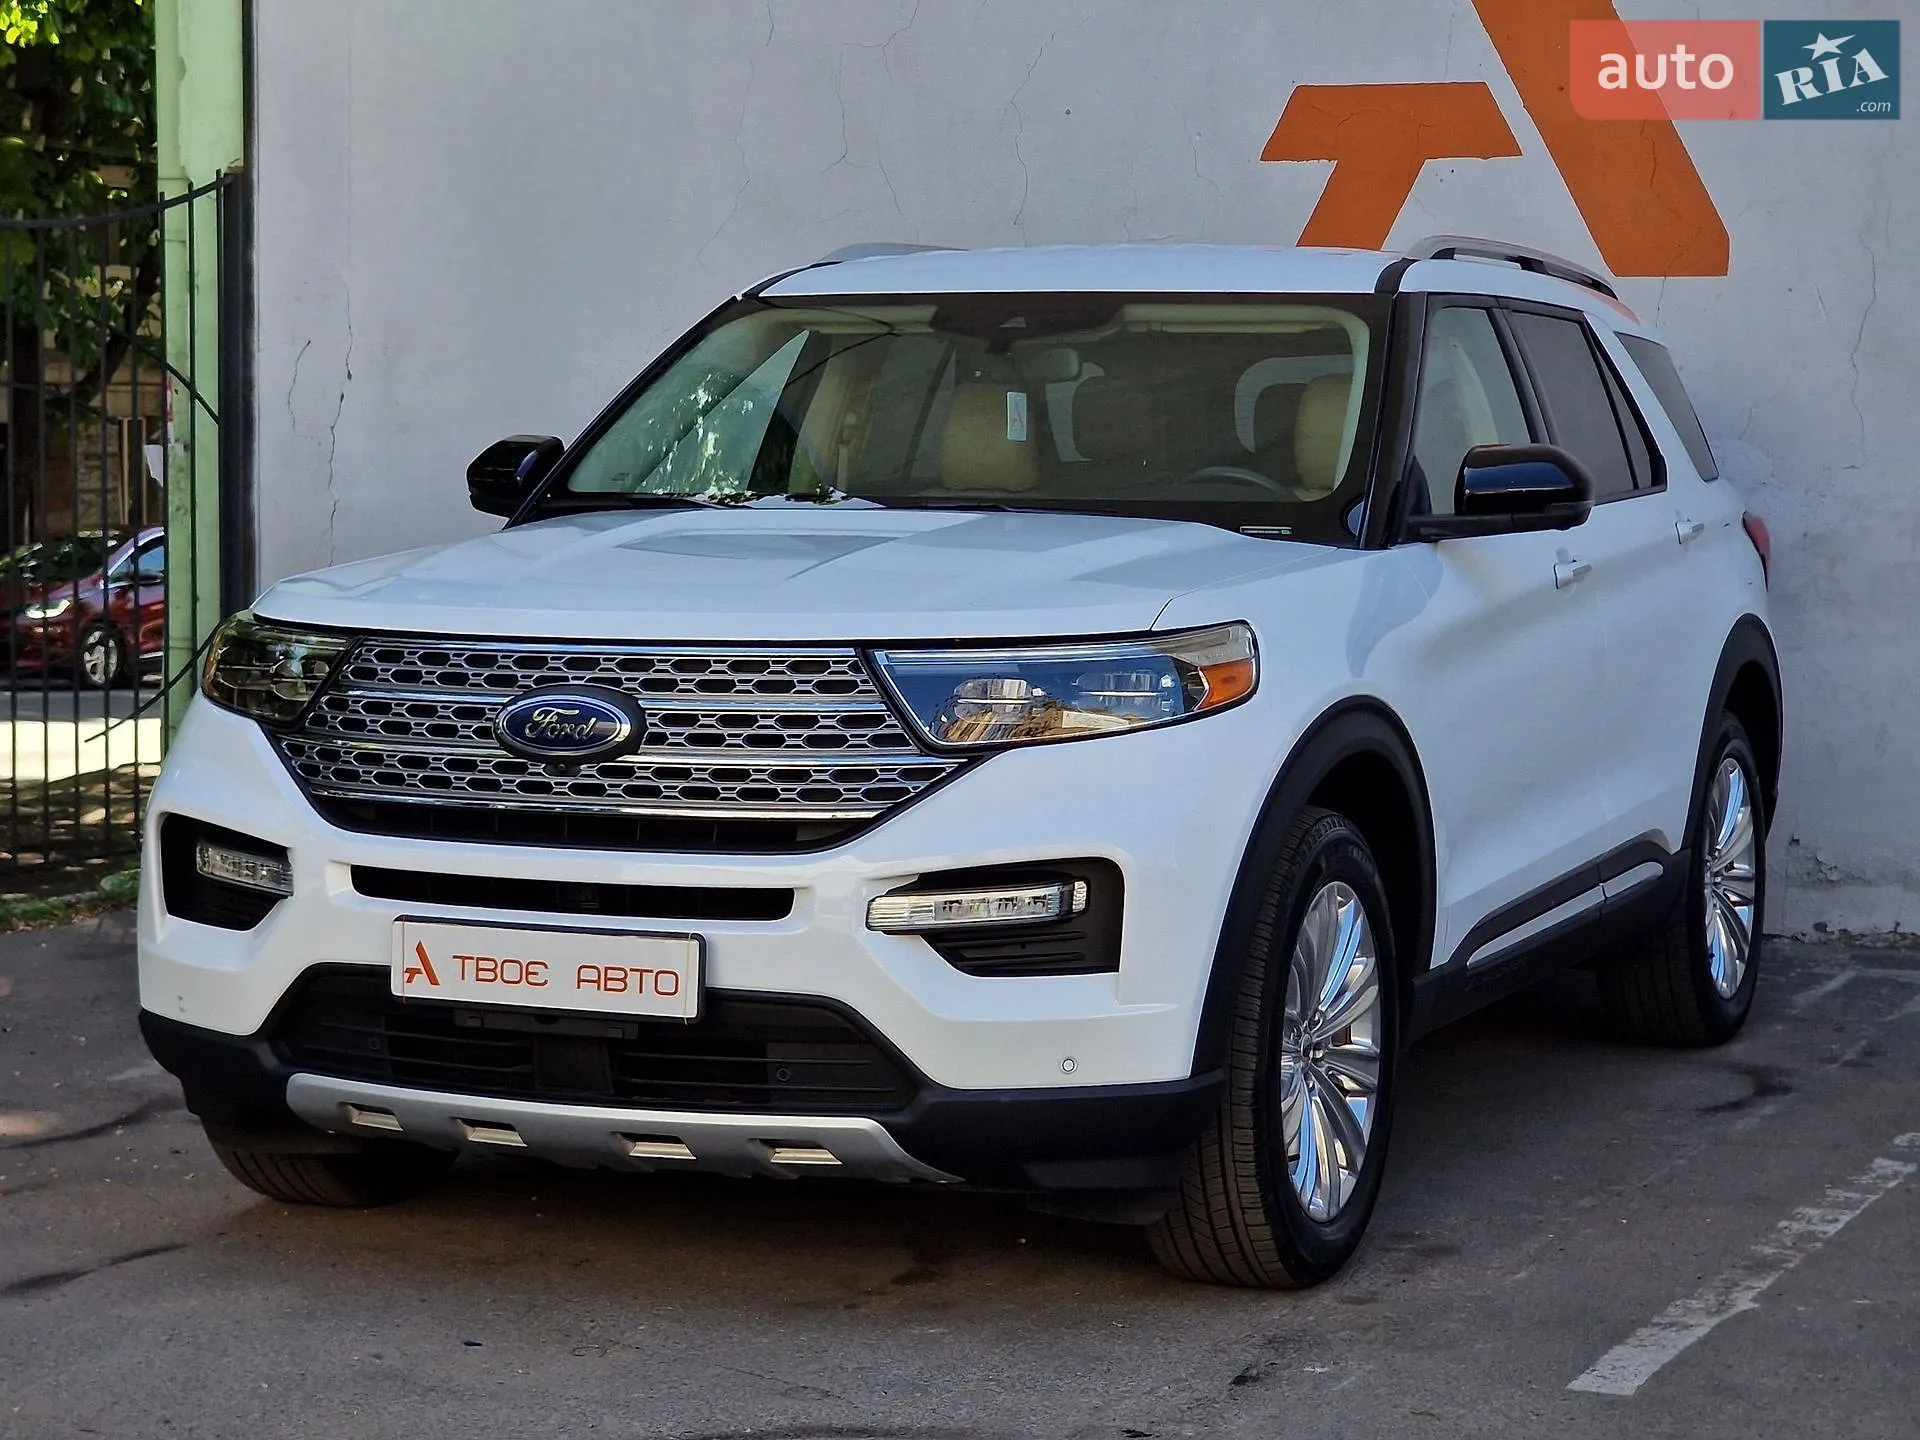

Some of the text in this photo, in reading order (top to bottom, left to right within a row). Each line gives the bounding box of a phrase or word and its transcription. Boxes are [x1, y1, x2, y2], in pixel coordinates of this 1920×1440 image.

[525, 707, 597, 740] Ford
[452, 954, 549, 987] ТВОЄ
[576, 964, 680, 996] АВТО
